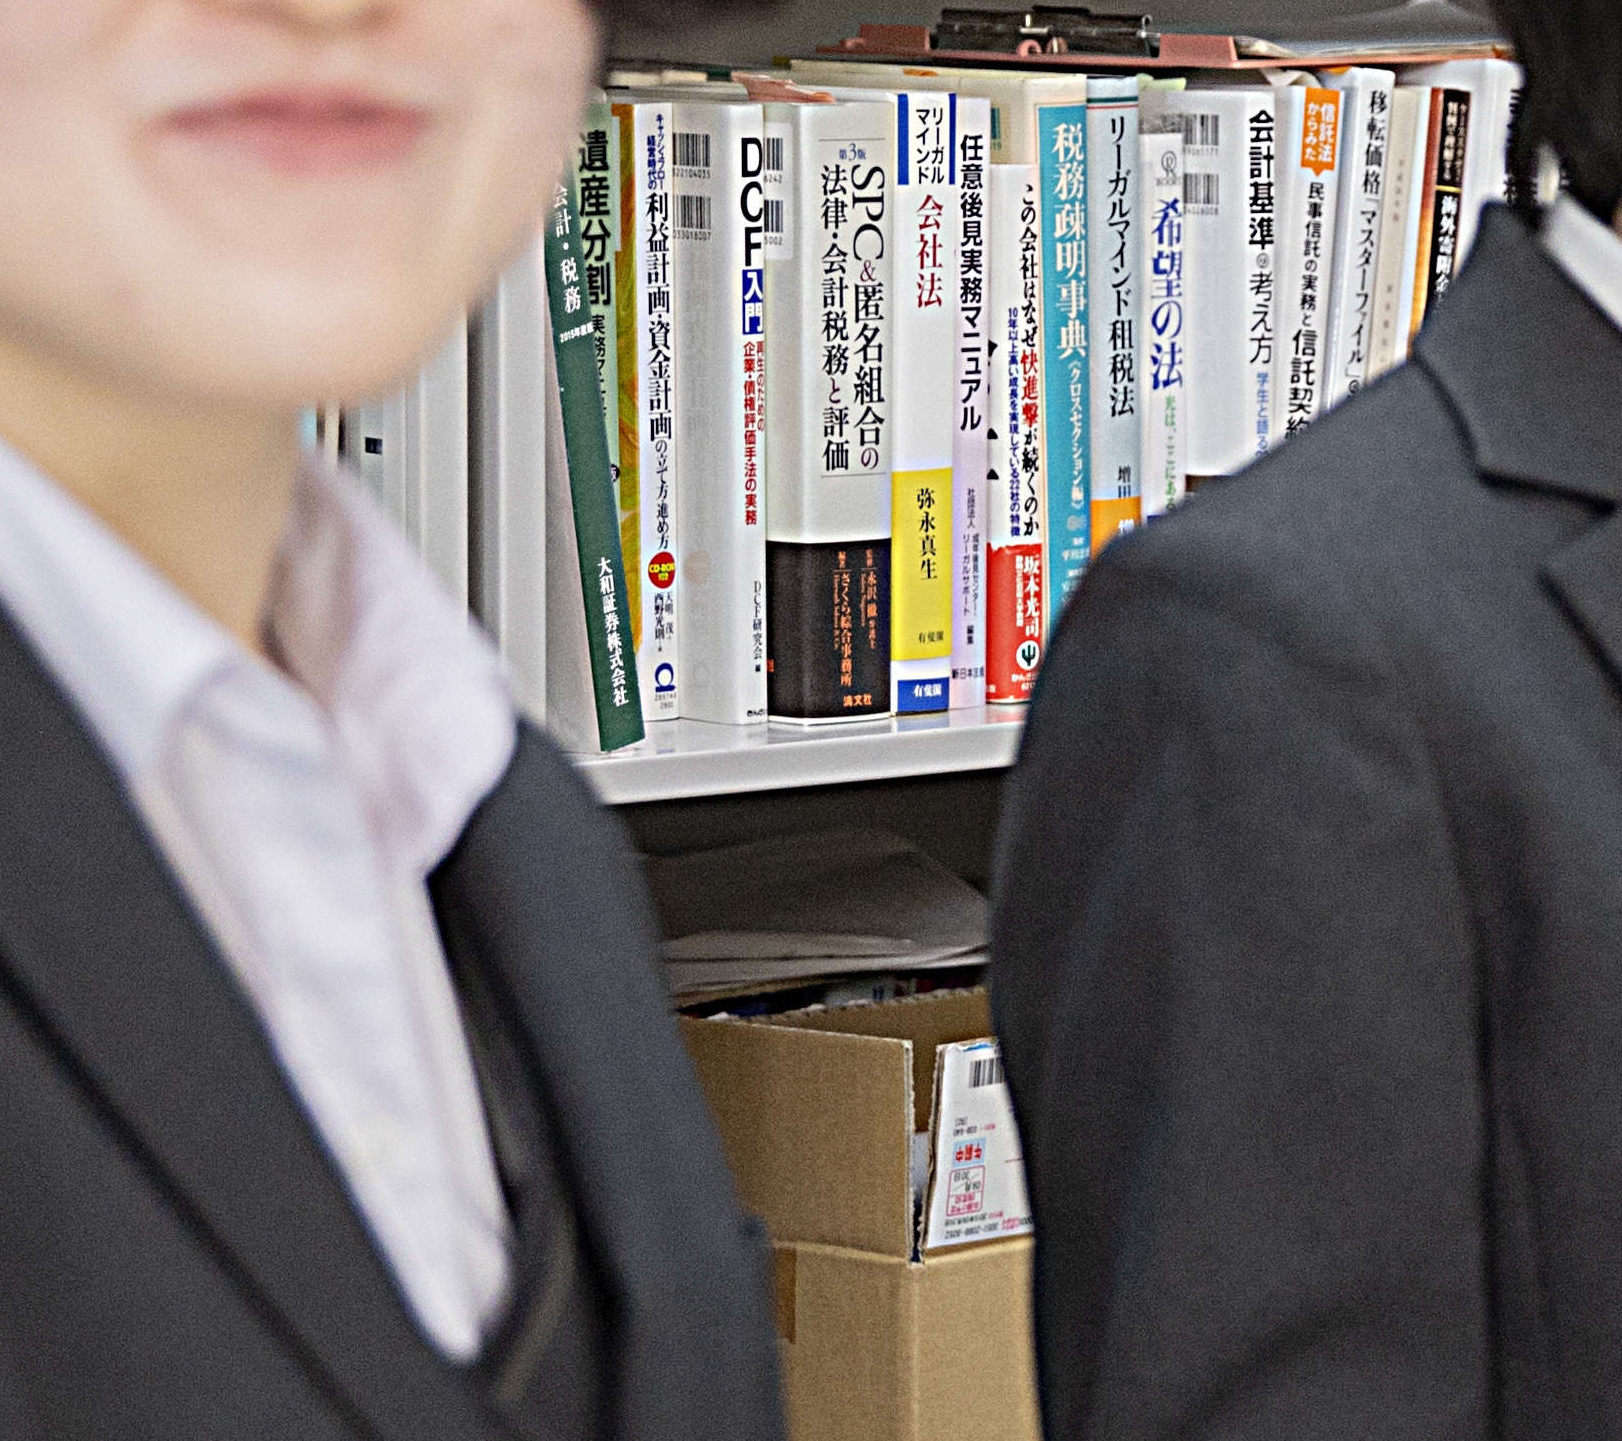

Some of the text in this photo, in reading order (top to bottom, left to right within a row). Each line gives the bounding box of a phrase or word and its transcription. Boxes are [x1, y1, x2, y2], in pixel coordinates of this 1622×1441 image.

[578, 128, 612, 307] 遺産分割
[914, 107, 932, 185] マインド
[930, 105, 946, 185] リーガル
[1302, 103, 1321, 162] からみた
[1318, 100, 1338, 164] 信託法
[739, 136, 765, 336] DCF 入門
[820, 162, 850, 473] 法律・会計税務と評価
[850, 162, 887, 472] SPC&匿名組合の
[915, 192, 945, 311] 会社法
[959, 132, 985, 433] 任意後見実務マニュアル
[1051, 121, 1088, 362] 税務疎明事典
[1107, 114, 1136, 418] リーガルマインド租税法
[1149, 196, 1185, 392] 希望の法
[644, 189, 673, 551] 利益計画・資金計画の立て方・進め方
[742, 342, 758, 527] 企業・債権評価手法の実務
[1018, 181, 1041, 538] この会社はなぜ快進撃が続くのか
[915, 486, 940, 582] 弥永真生
[1022, 553, 1041, 640] 坂本光司
[597, 556, 630, 709] 大和証券株式会社
